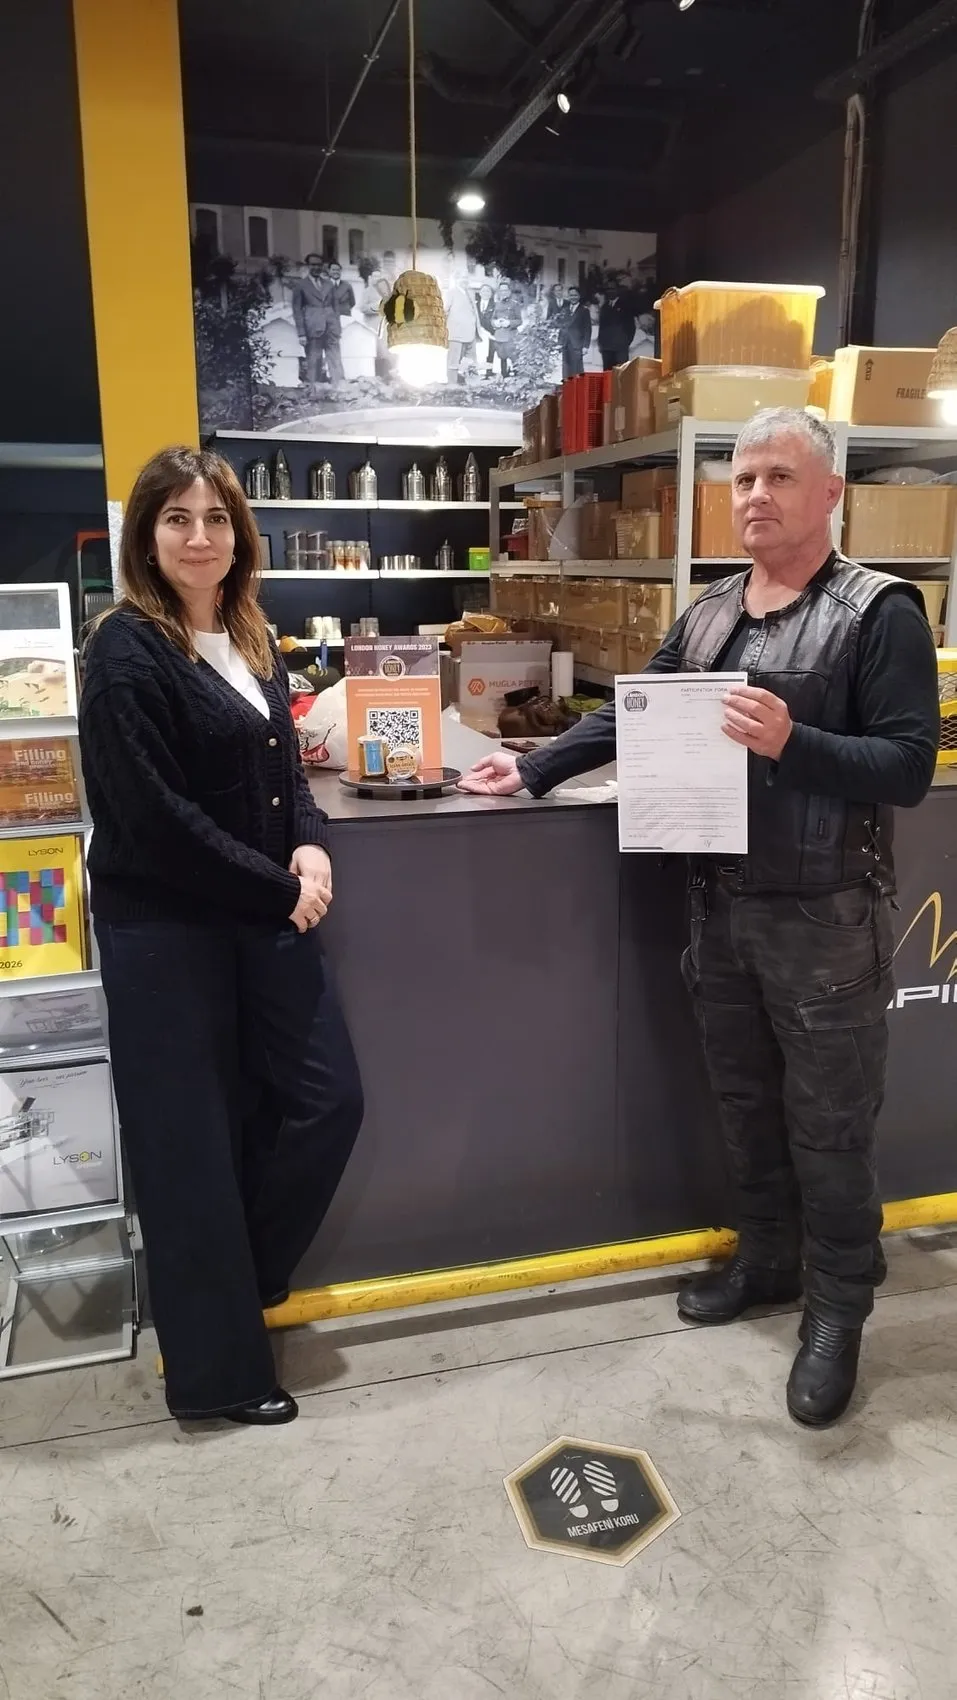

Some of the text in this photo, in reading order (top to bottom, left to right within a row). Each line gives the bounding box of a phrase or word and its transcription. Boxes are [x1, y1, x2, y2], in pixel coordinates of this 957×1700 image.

[896, 388, 927, 399] FRAGILE
[14, 748, 67, 761] Filling
[24, 791, 74, 804] Filling
[28, 847, 64, 856] LYSON
[0, 960, 23, 969] 2026
[53, 1150, 102, 1165] LYSON
[567, 1513, 640, 1537] MESAFENİ KORU
